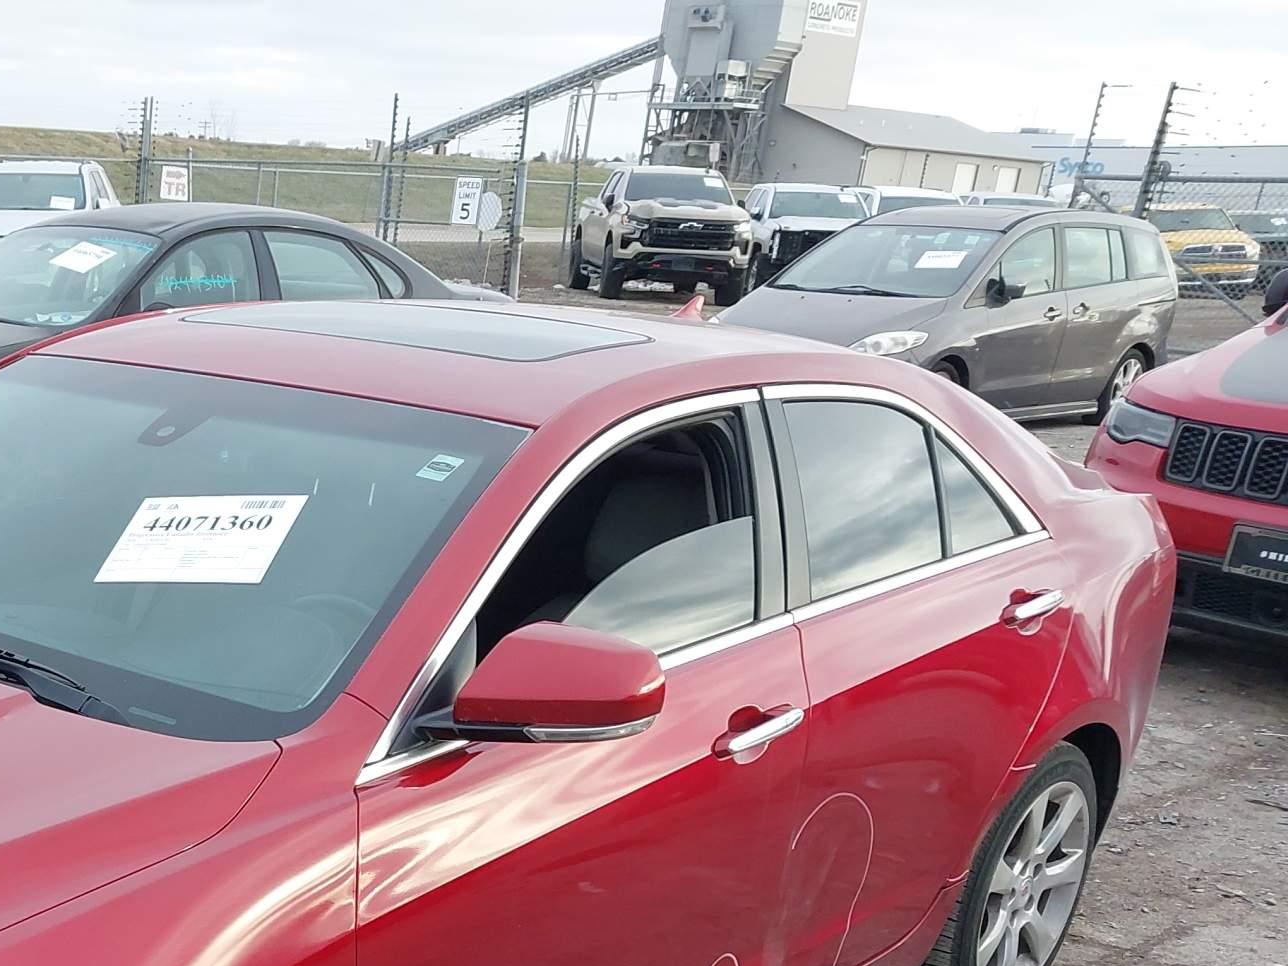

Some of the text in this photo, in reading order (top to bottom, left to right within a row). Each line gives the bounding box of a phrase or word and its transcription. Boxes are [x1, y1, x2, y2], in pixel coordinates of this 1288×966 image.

[809, 2, 858, 22] ROANOKE
[458, 181, 481, 189] SPEED
[459, 203, 471, 220] 5
[143, 514, 274, 532] 44071360
